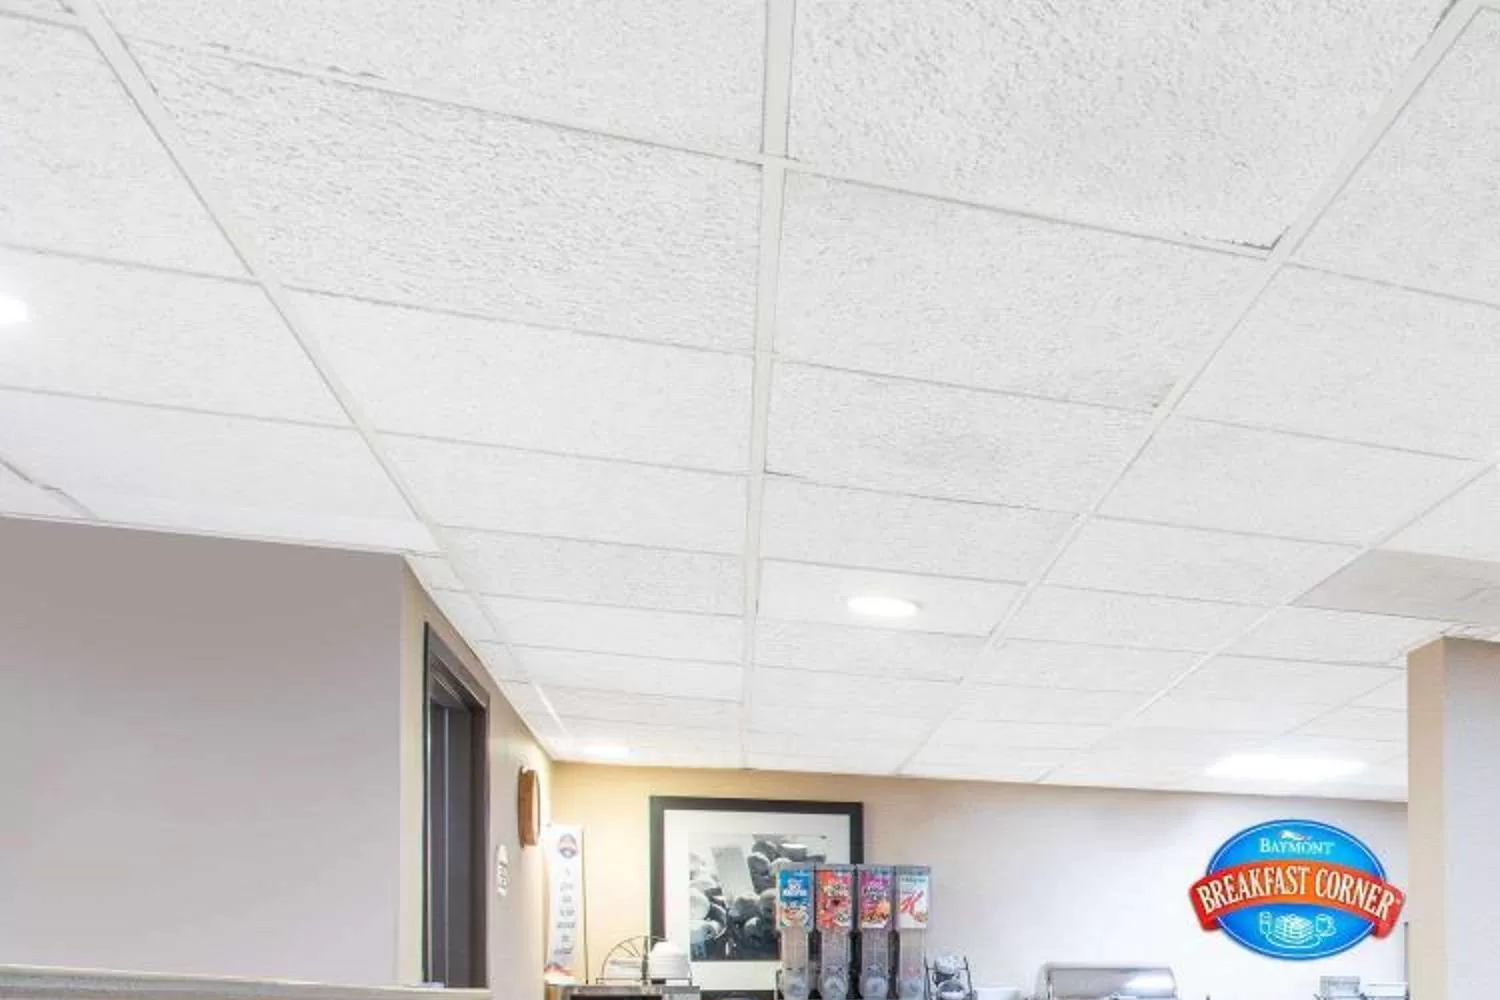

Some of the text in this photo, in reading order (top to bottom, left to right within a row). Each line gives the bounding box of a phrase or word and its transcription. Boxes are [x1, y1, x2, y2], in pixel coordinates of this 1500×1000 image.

[1259, 837, 1336, 855] BAYMONT
[1197, 865, 1395, 921] BREAKFAST CORNER
